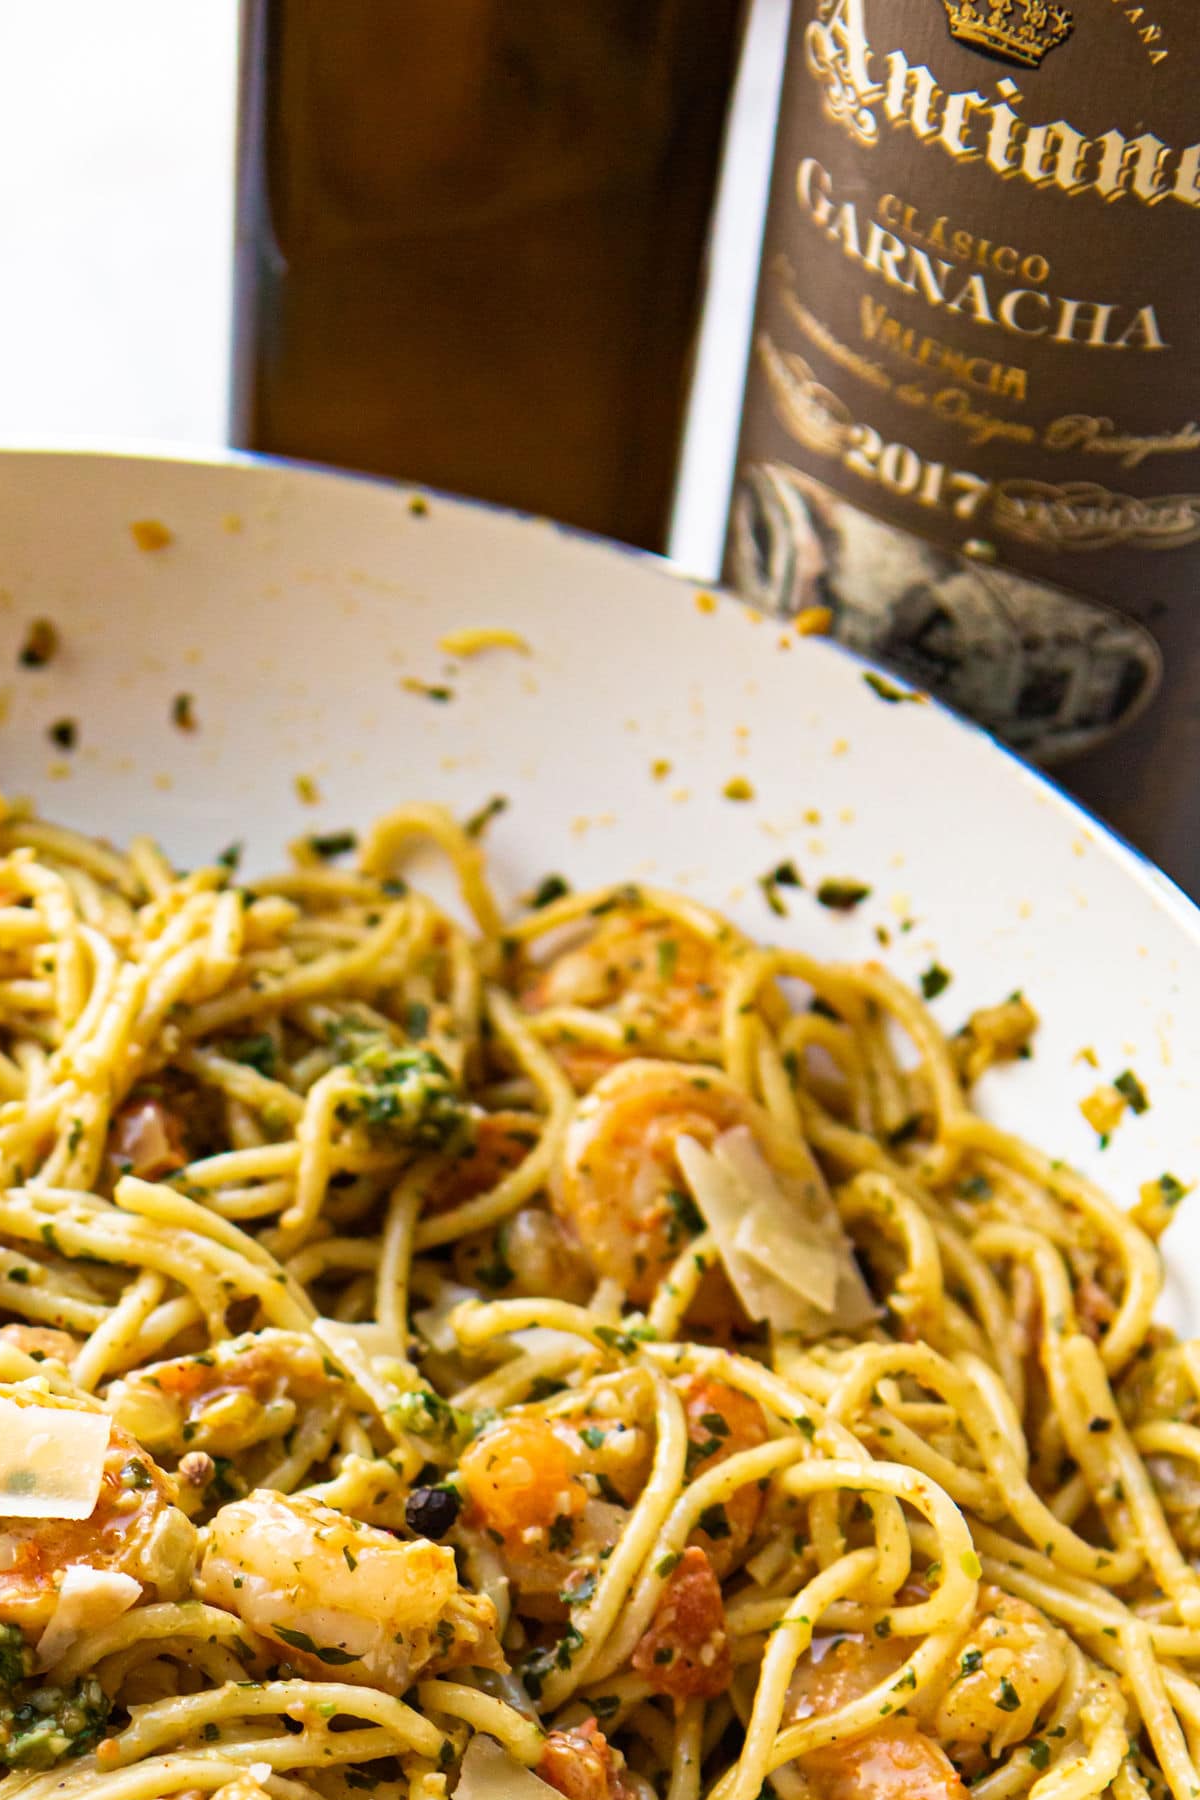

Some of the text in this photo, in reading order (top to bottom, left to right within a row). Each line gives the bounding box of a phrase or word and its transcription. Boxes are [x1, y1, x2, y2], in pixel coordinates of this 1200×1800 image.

[796, 156, 1171, 350] GARNACHA
[876, 193, 1051, 284] CLÁSICO
[859, 292, 1029, 402] VALENCIA
[842, 424, 988, 519] 2017
